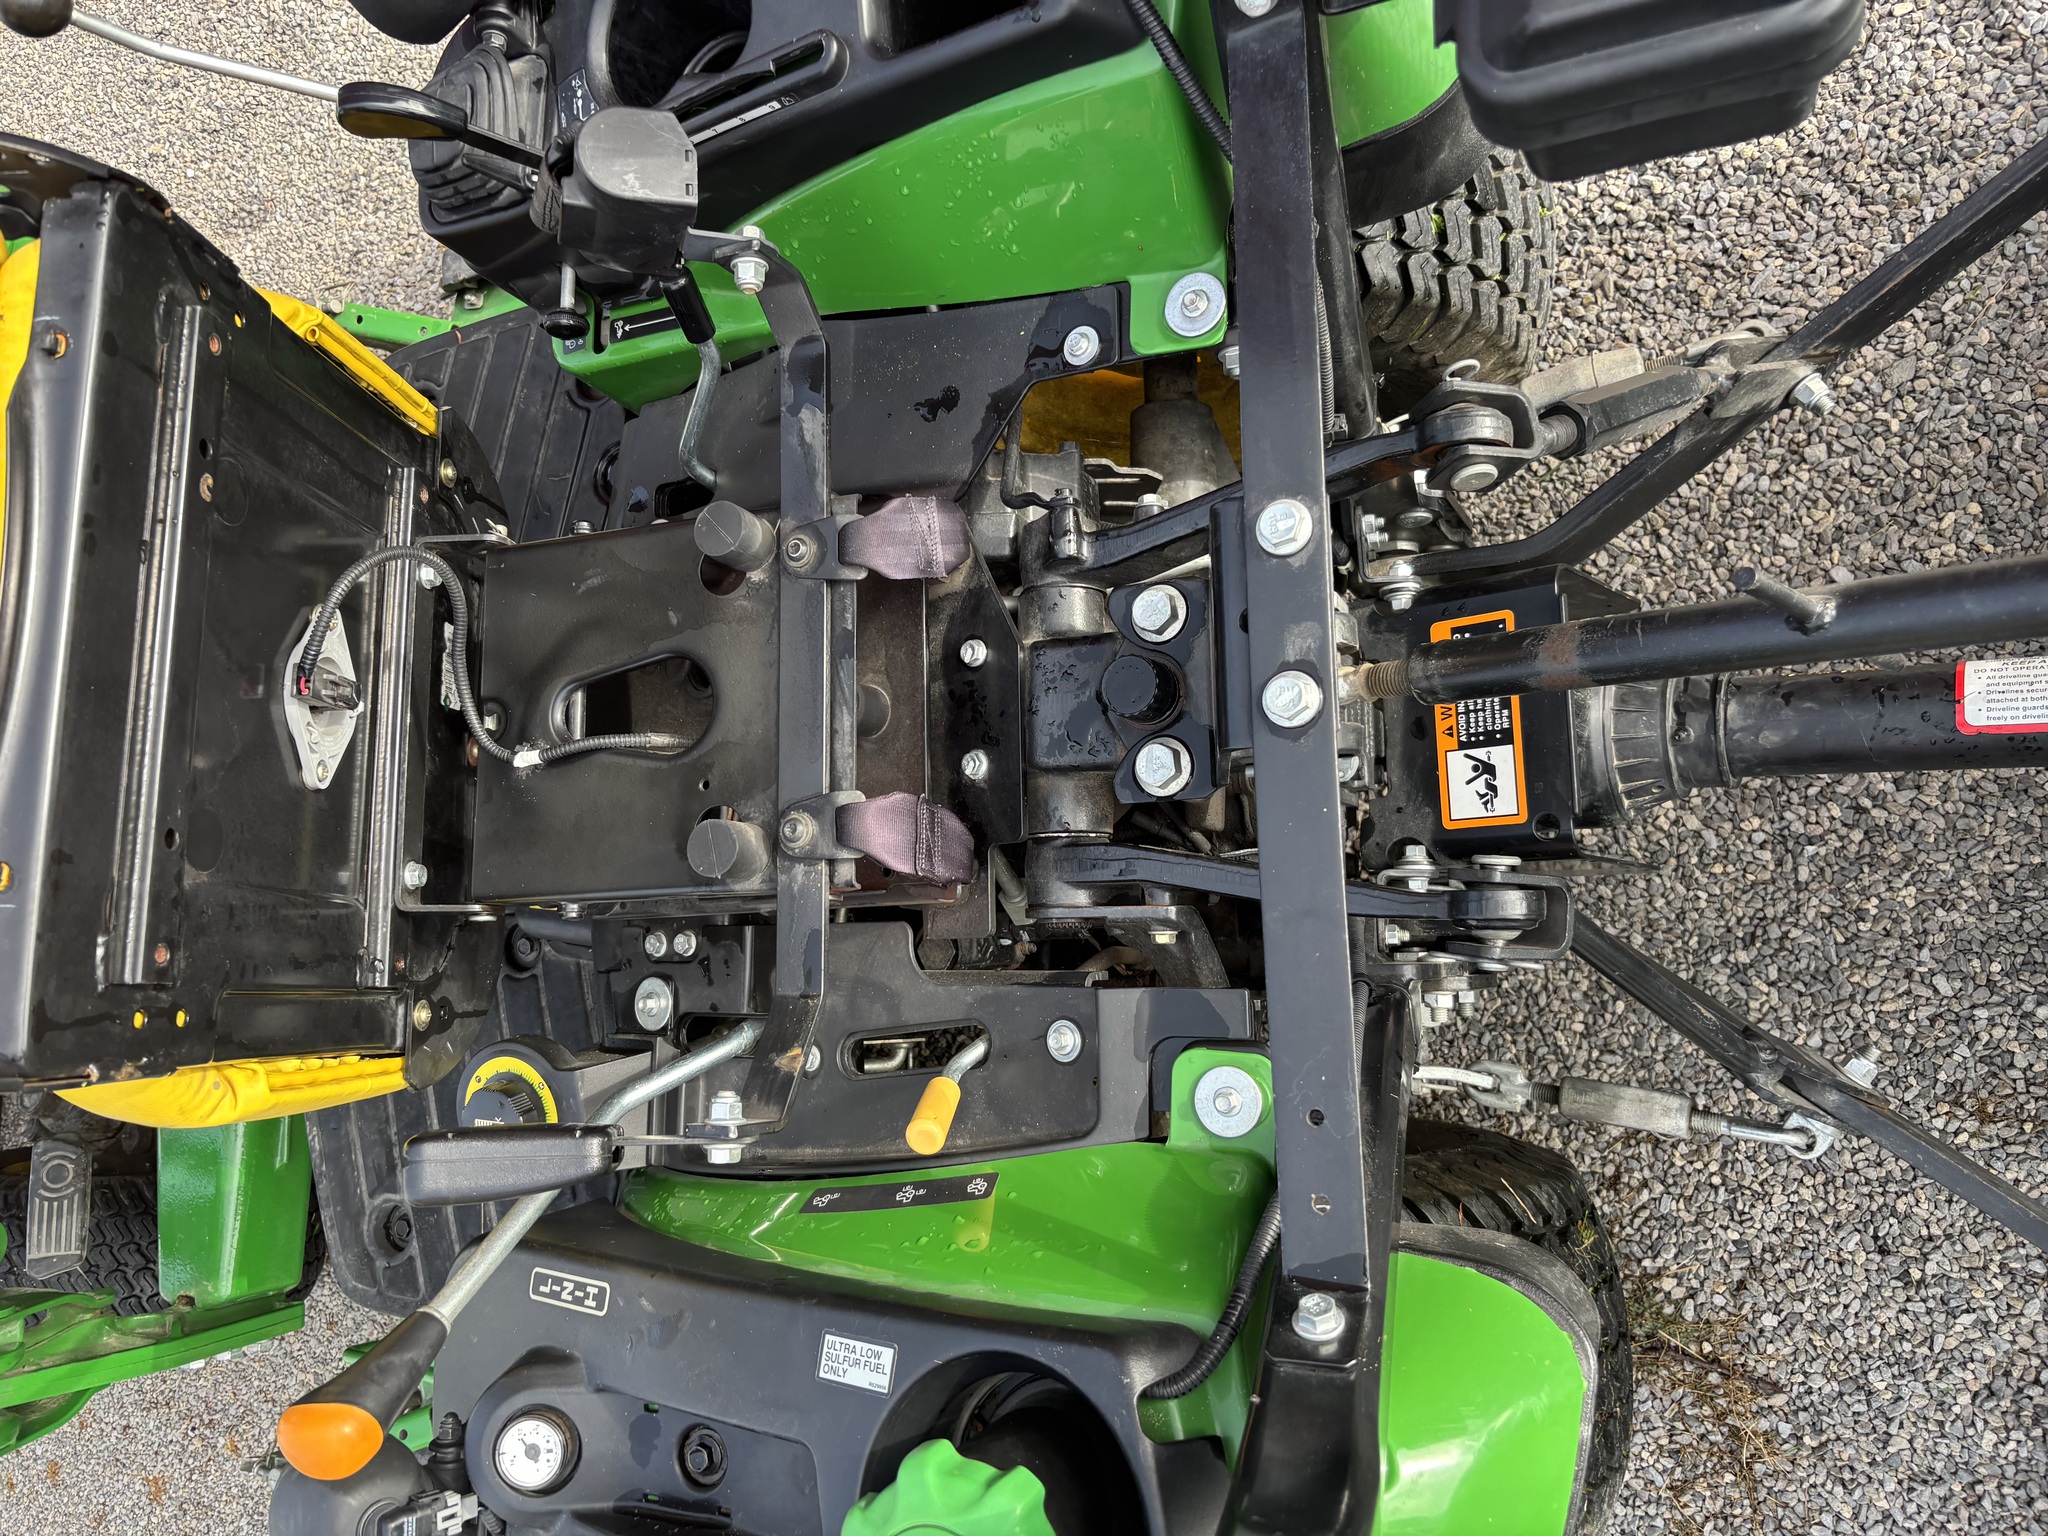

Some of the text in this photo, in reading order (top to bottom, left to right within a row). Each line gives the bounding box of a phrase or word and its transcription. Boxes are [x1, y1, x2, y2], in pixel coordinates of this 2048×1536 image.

[1986, 696, 2019, 704] attached
[1458, 714, 1468, 742] AVOID
[1469, 712, 1477, 733] Keep
[1477, 711, 1485, 732] Keep
[1502, 709, 1510, 729] RPM
[1986, 714, 2008, 722] freely
[826, 1339, 883, 1361] ULTRA LOW
[822, 1363, 848, 1378] ONLY
[824, 1351, 888, 1376] SULFUR FUEL
